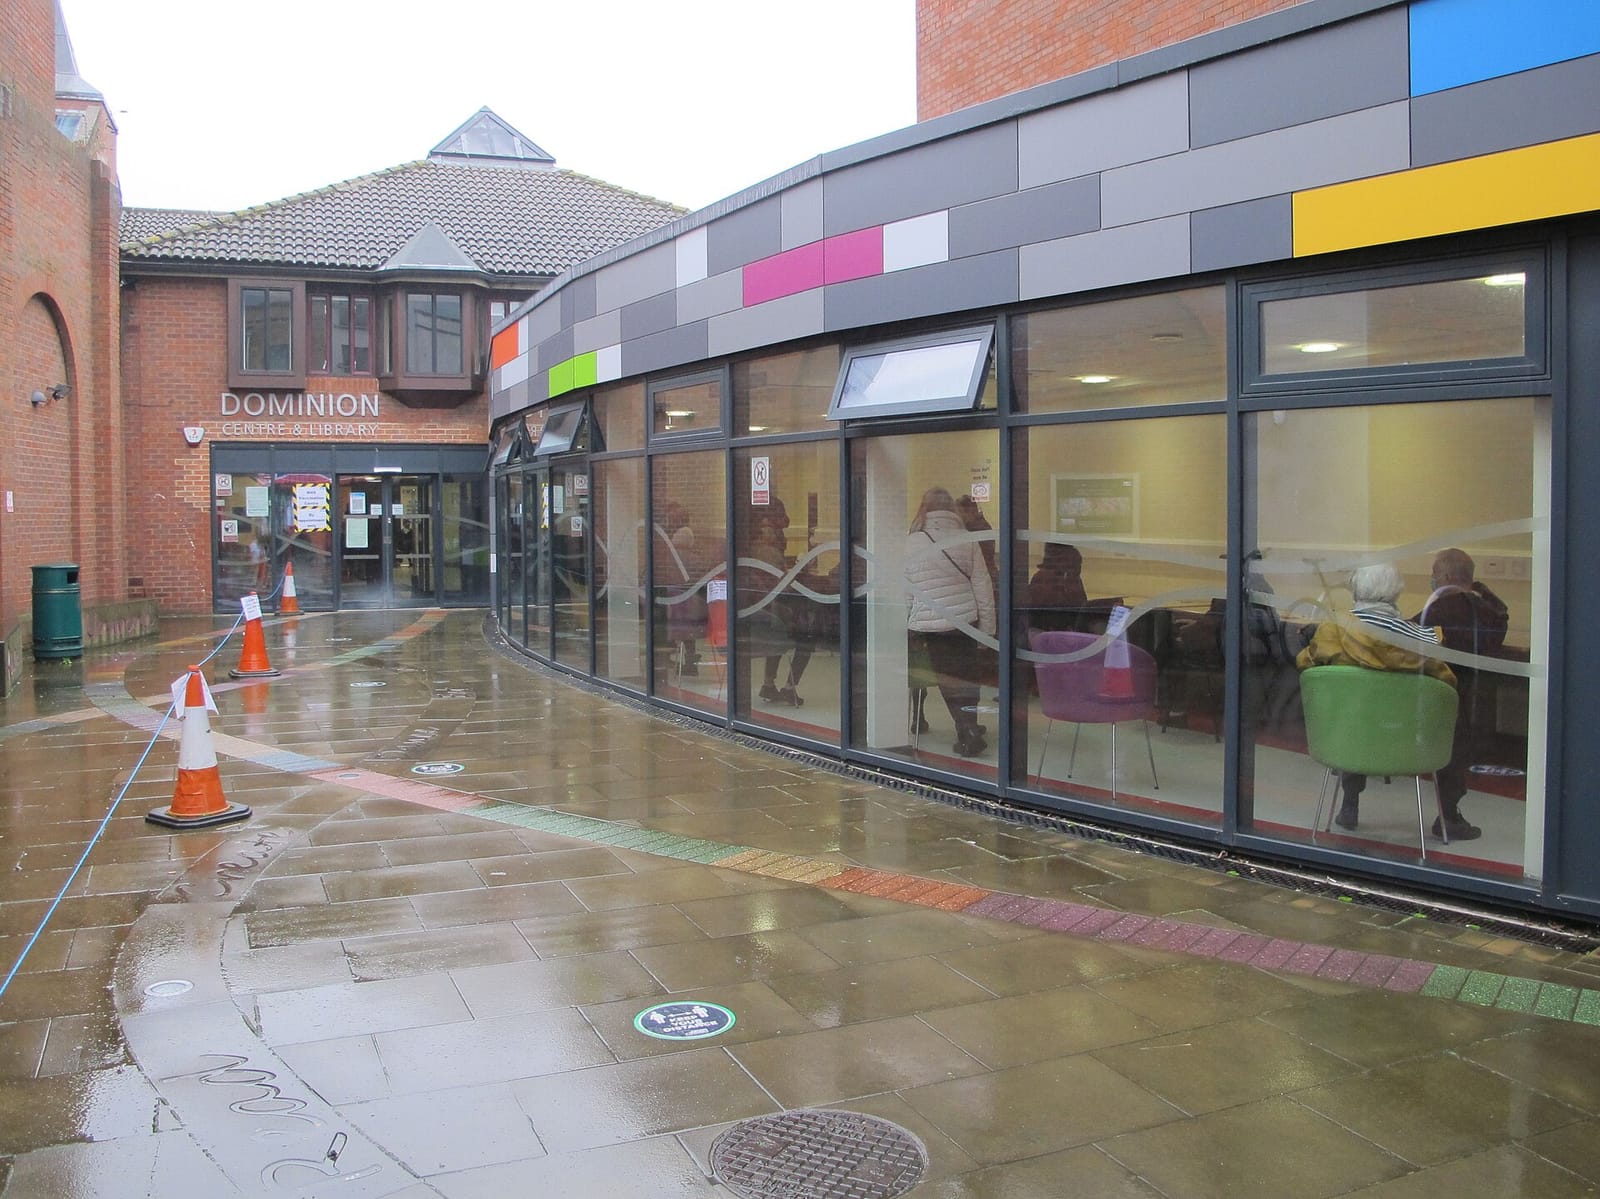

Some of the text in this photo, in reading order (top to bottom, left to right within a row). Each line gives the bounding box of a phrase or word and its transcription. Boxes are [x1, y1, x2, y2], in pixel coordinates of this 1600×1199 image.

[221, 392, 379, 417] DOMINION
[222, 423, 379, 436] CENTRE & LIBRARY
[662, 1020, 719, 1033] DISTANCE
[670, 1018, 704, 1026] YOUR
